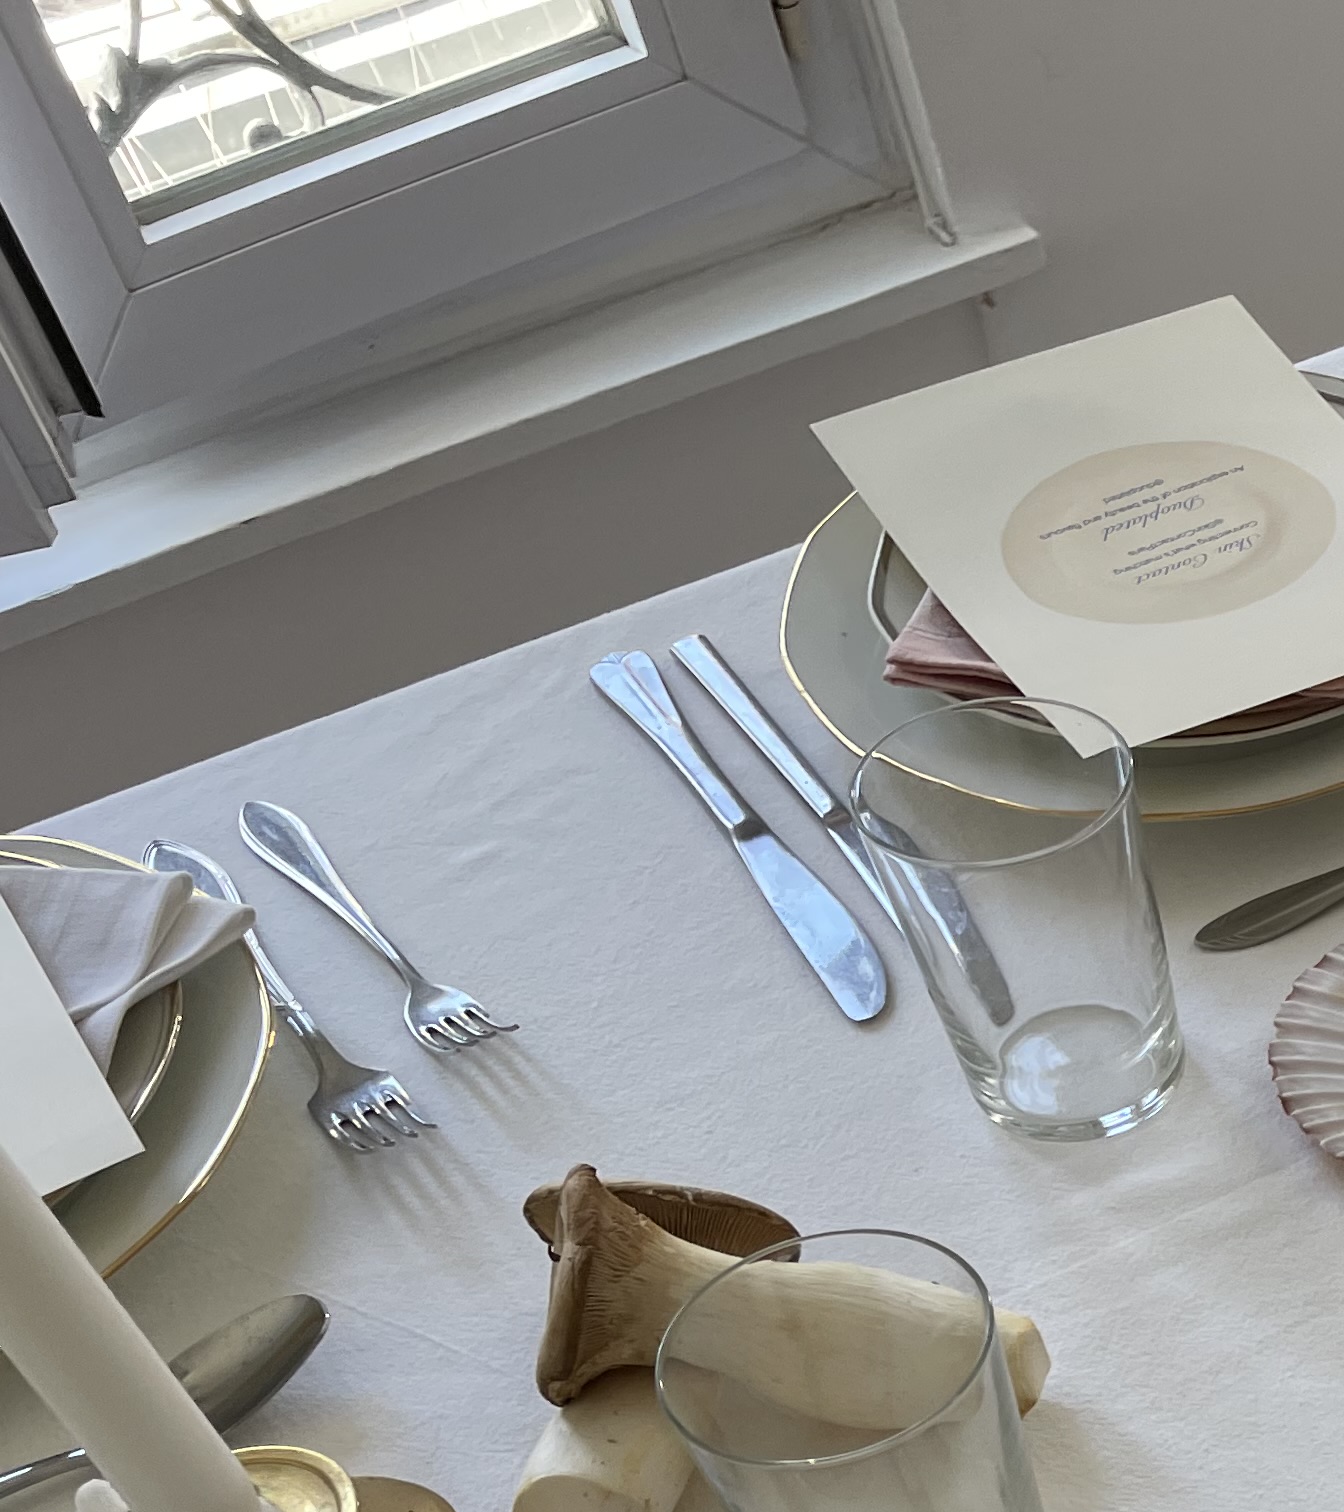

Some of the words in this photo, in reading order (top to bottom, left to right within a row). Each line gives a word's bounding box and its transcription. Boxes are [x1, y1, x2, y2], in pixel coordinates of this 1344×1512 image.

[1103, 494, 1205, 542] Duoplated
[1218, 533, 1261, 553] Skin
[1136, 553, 1207, 585] Contact
